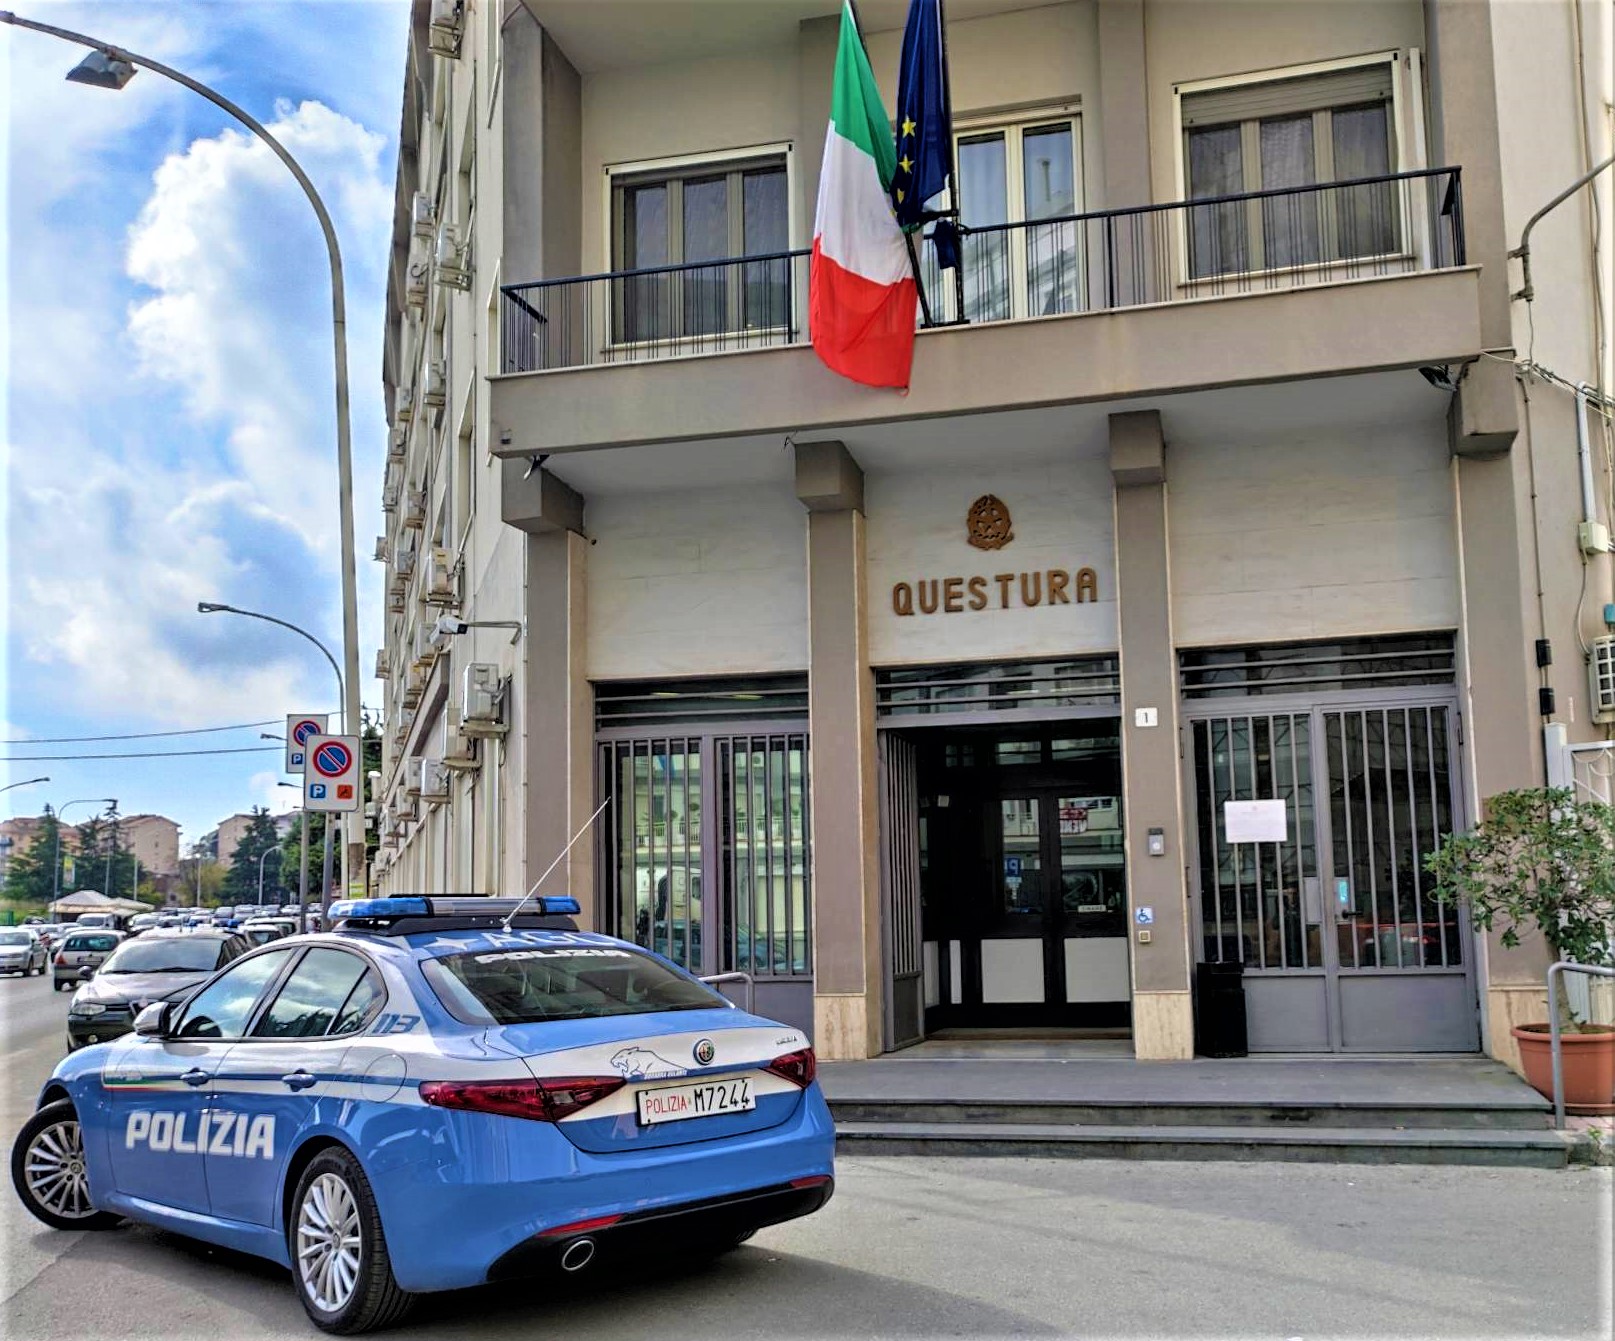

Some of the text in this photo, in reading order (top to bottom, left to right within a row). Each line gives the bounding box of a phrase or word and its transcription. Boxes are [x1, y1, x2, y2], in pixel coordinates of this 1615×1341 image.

[892, 567, 1098, 616] QUESTURA
[474, 949, 631, 964] POLIZIA
[371, 1013, 421, 1034] 113
[645, 1083, 750, 1114] POLIZIA M7244
[126, 1110, 276, 1160] POLIZIA
